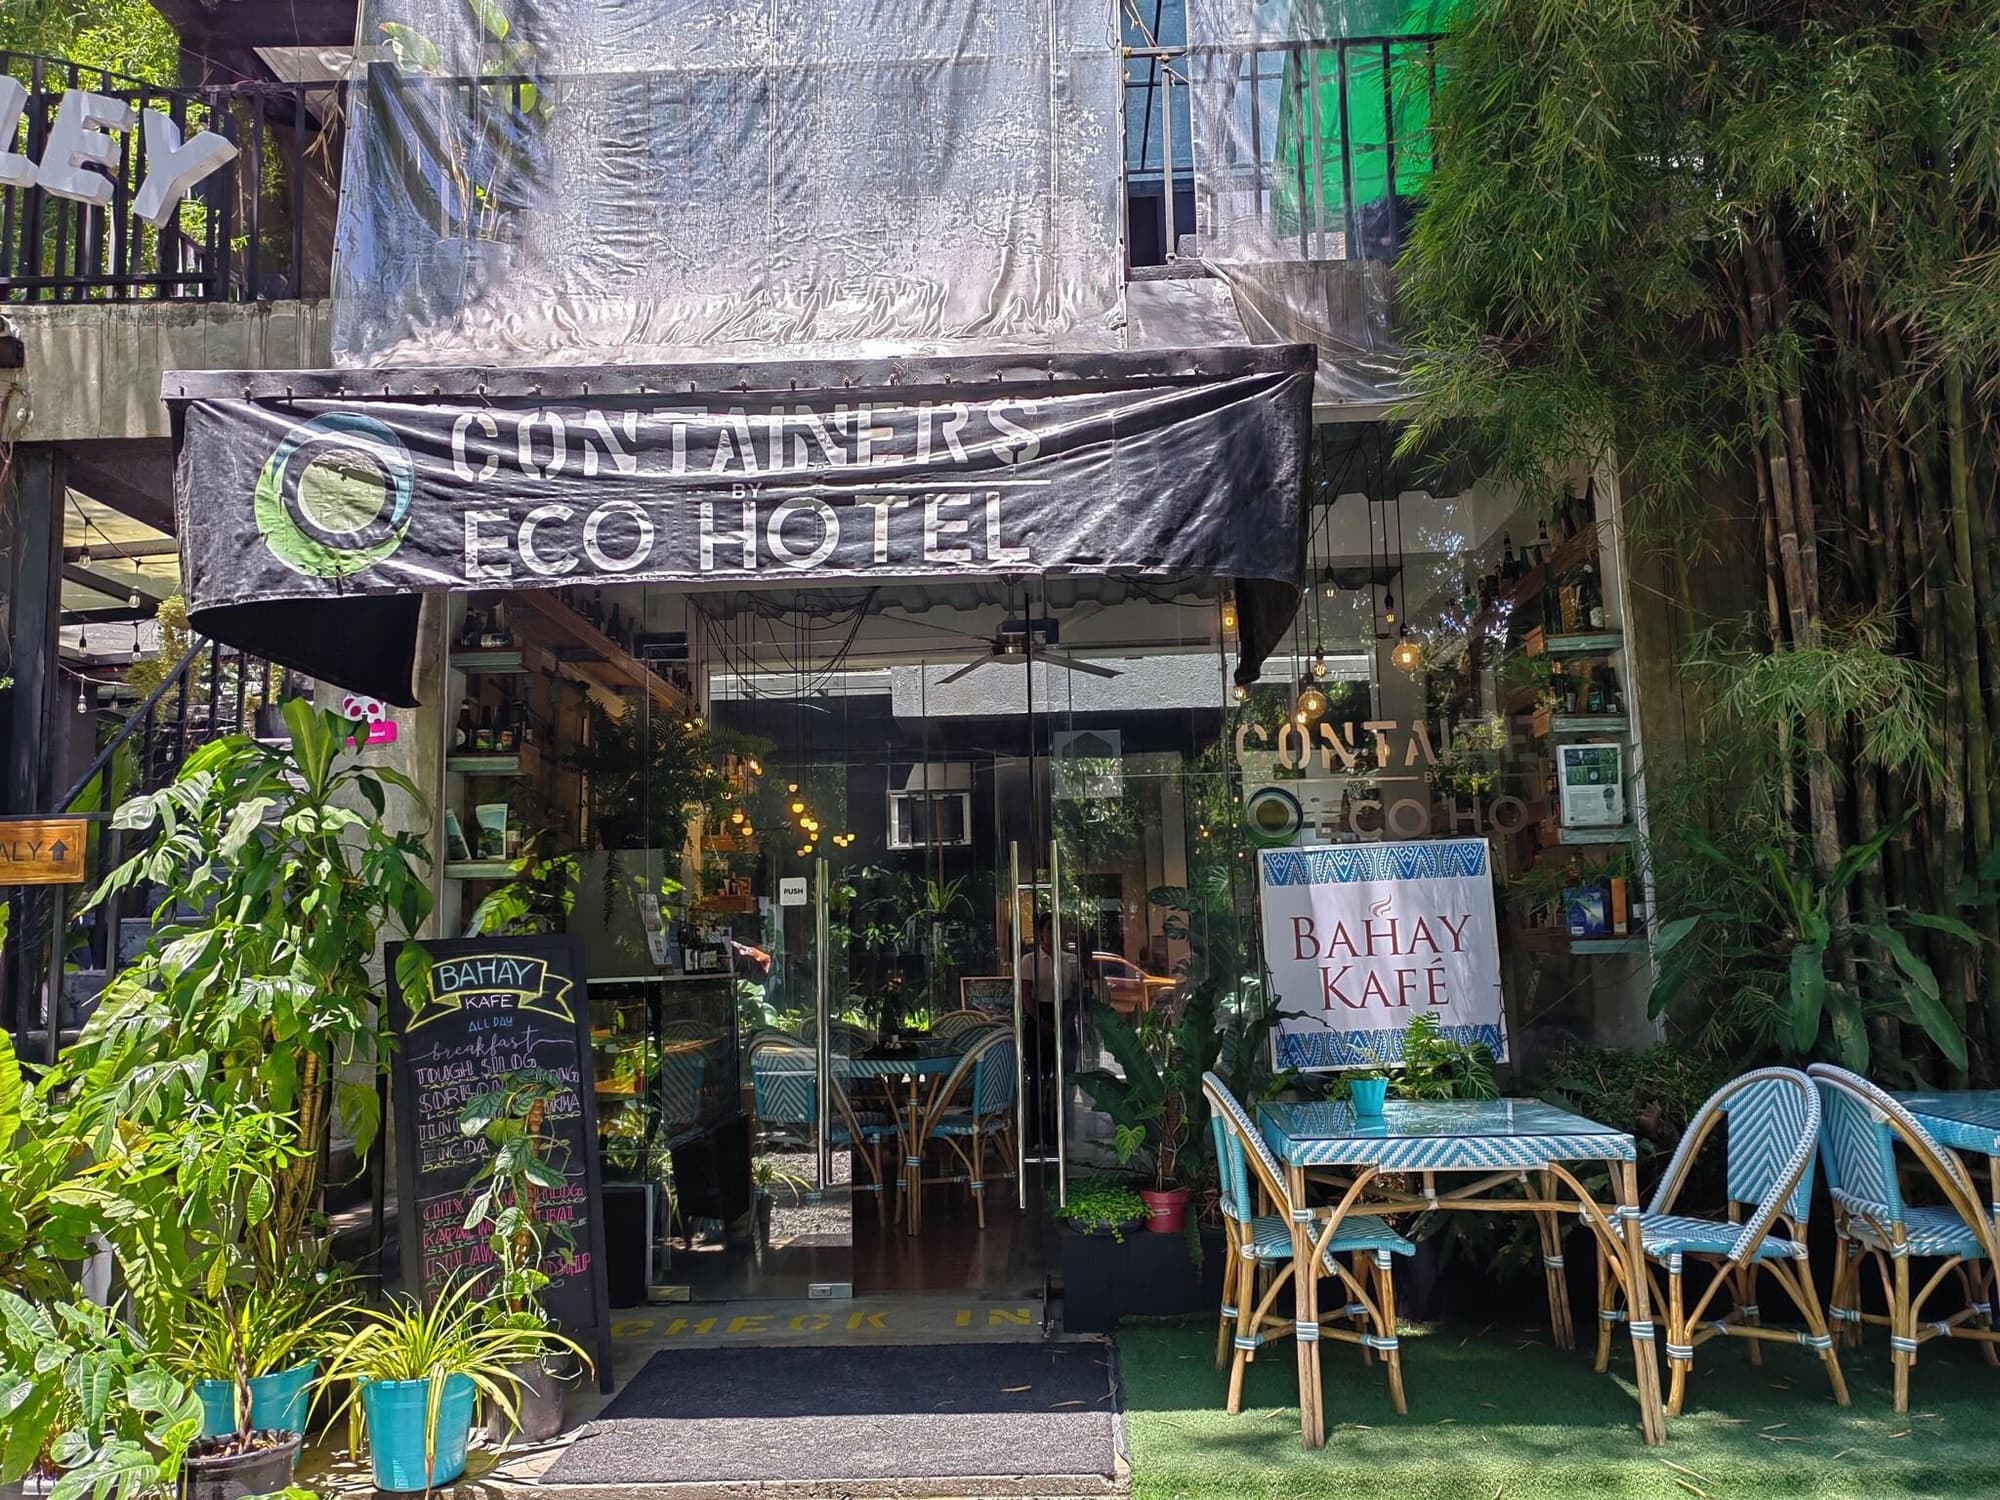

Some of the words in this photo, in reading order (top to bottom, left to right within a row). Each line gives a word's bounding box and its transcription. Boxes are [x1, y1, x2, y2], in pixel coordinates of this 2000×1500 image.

[453, 396, 1041, 482] CONTAINERS
[732, 483, 762, 499] BY
[464, 501, 655, 577] ECO
[700, 491, 1030, 570] HOTEL
[783, 888, 804, 896] PUSH
[1290, 914, 1472, 960] BAHAY
[440, 960, 535, 991] BAHAY
[1319, 957, 1450, 1011] KAFÉ
[465, 994, 514, 1009] KAFE
[468, 1019, 489, 1032] ALL
[493, 1016, 513, 1027] DAY
[414, 1025, 560, 1061] breakfast
[415, 1060, 474, 1085] TOUGH
[481, 1051, 537, 1077] SILOG
[611, 1311, 891, 1337] CHECK
[955, 1308, 1032, 1327] IN
